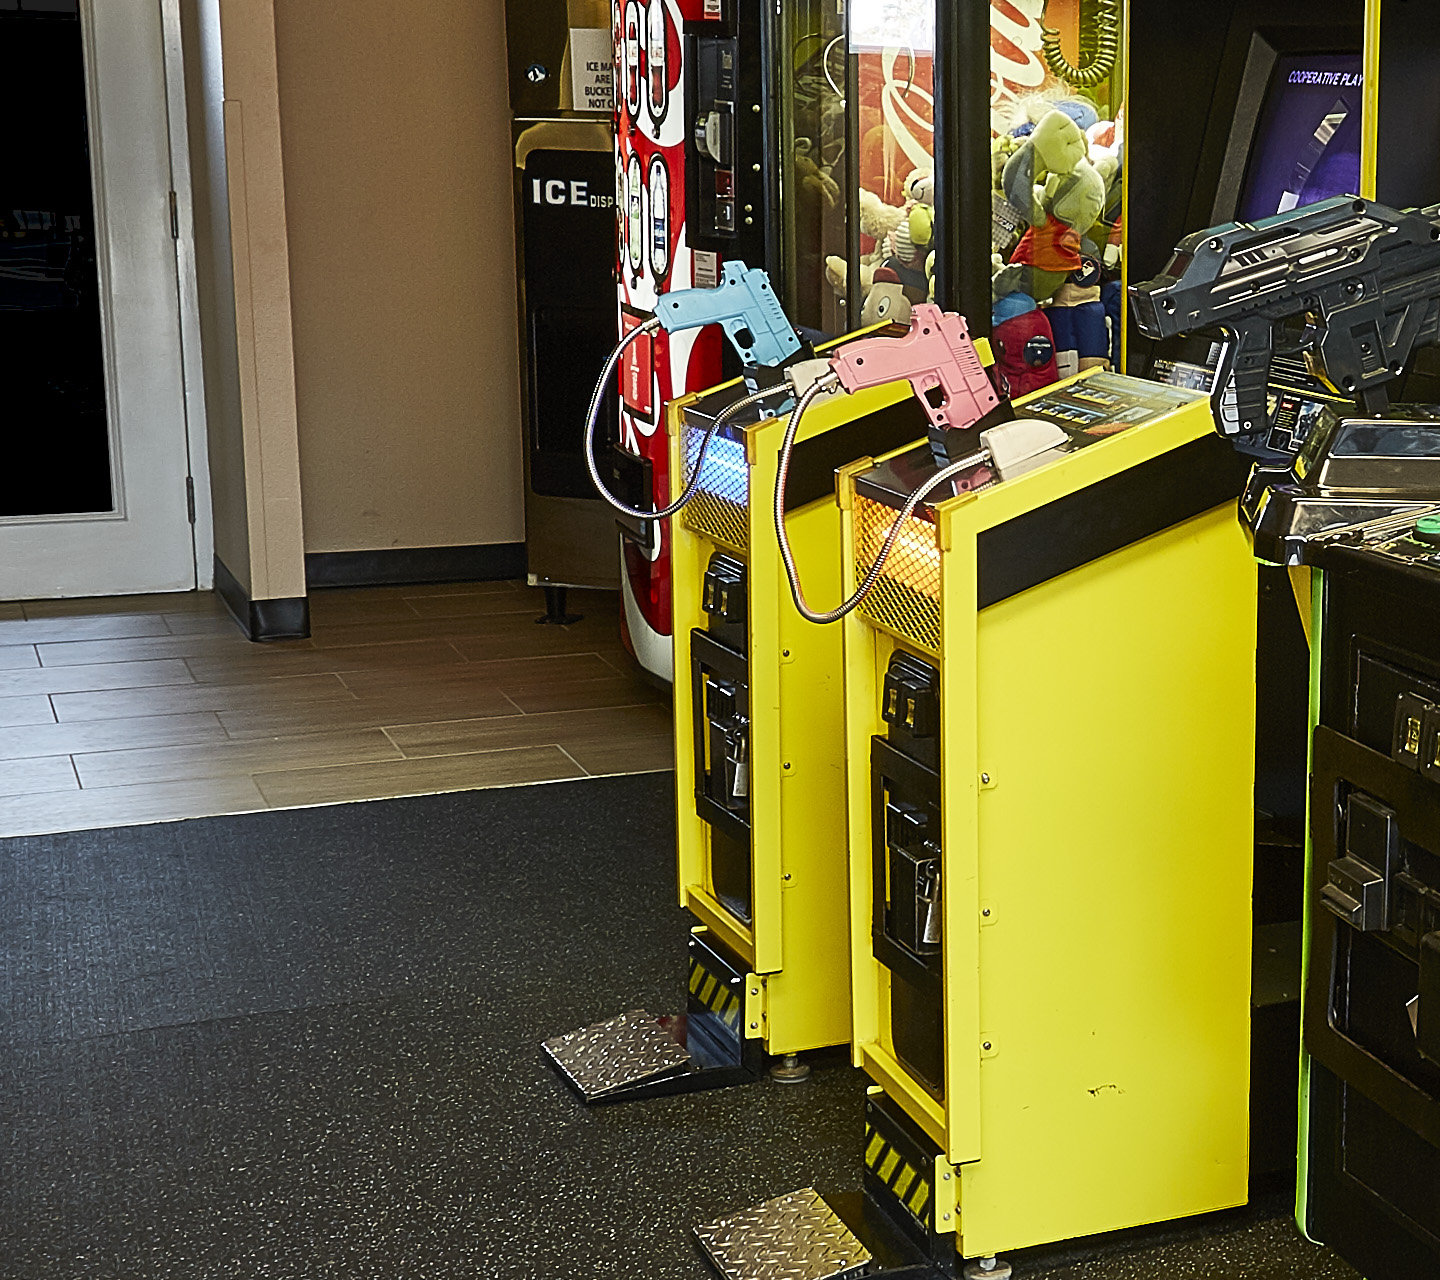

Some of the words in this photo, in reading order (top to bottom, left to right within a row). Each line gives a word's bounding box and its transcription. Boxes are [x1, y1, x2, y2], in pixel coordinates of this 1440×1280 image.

[586, 61, 599, 71] ICE
[595, 74, 611, 84] ARE
[1288, 70, 1342, 86] COOPERATIVE
[1340, 72, 1364, 87] PLAY
[588, 99, 606, 108] NOT
[532, 178, 588, 206] ICE
